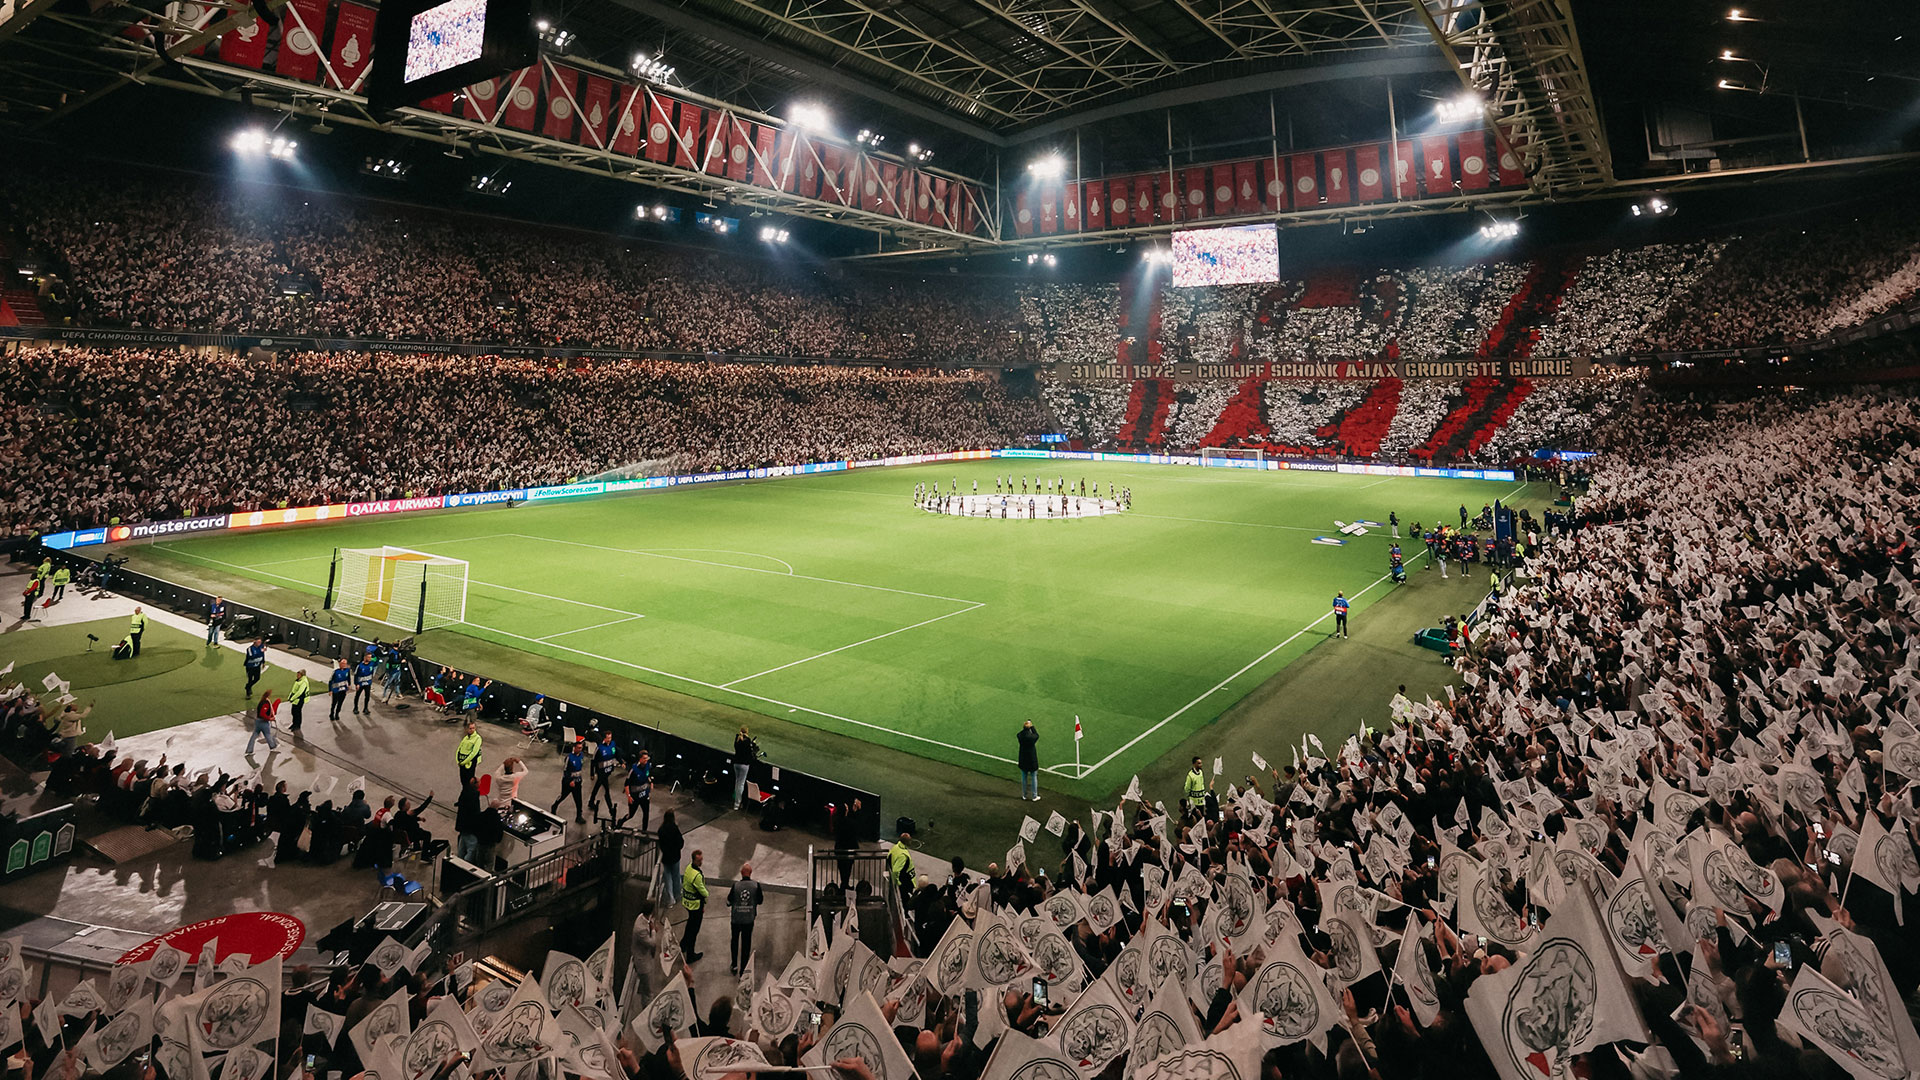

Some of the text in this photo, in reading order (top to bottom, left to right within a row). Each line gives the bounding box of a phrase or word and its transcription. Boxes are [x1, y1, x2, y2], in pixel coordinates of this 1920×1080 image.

[61, 331, 179, 343] UEFA CHAMPIONS LEAGUE
[1070, 364, 1090, 379] 31
[1095, 364, 1129, 379] MEI
[1133, 364, 1176, 379] 1972
[1197, 363, 1265, 379] CRUIJFF
[1270, 363, 1339, 378] SCHONK
[1345, 363, 1399, 378] AJAX
[1405, 361, 1502, 377] GROOTSTE
[1509, 359, 1573, 377] GLORIE
[766, 466, 793, 477] PEPSI
[1291, 462, 1337, 471] mastercard
[694, 473, 726, 484] CHAMPIONS
[727, 471, 747, 480] LEAGUE
[462, 490, 524, 505] crypto.com
[350, 497, 441, 516] QATAR AIRWAYS
[133, 515, 226, 537] mastercard
